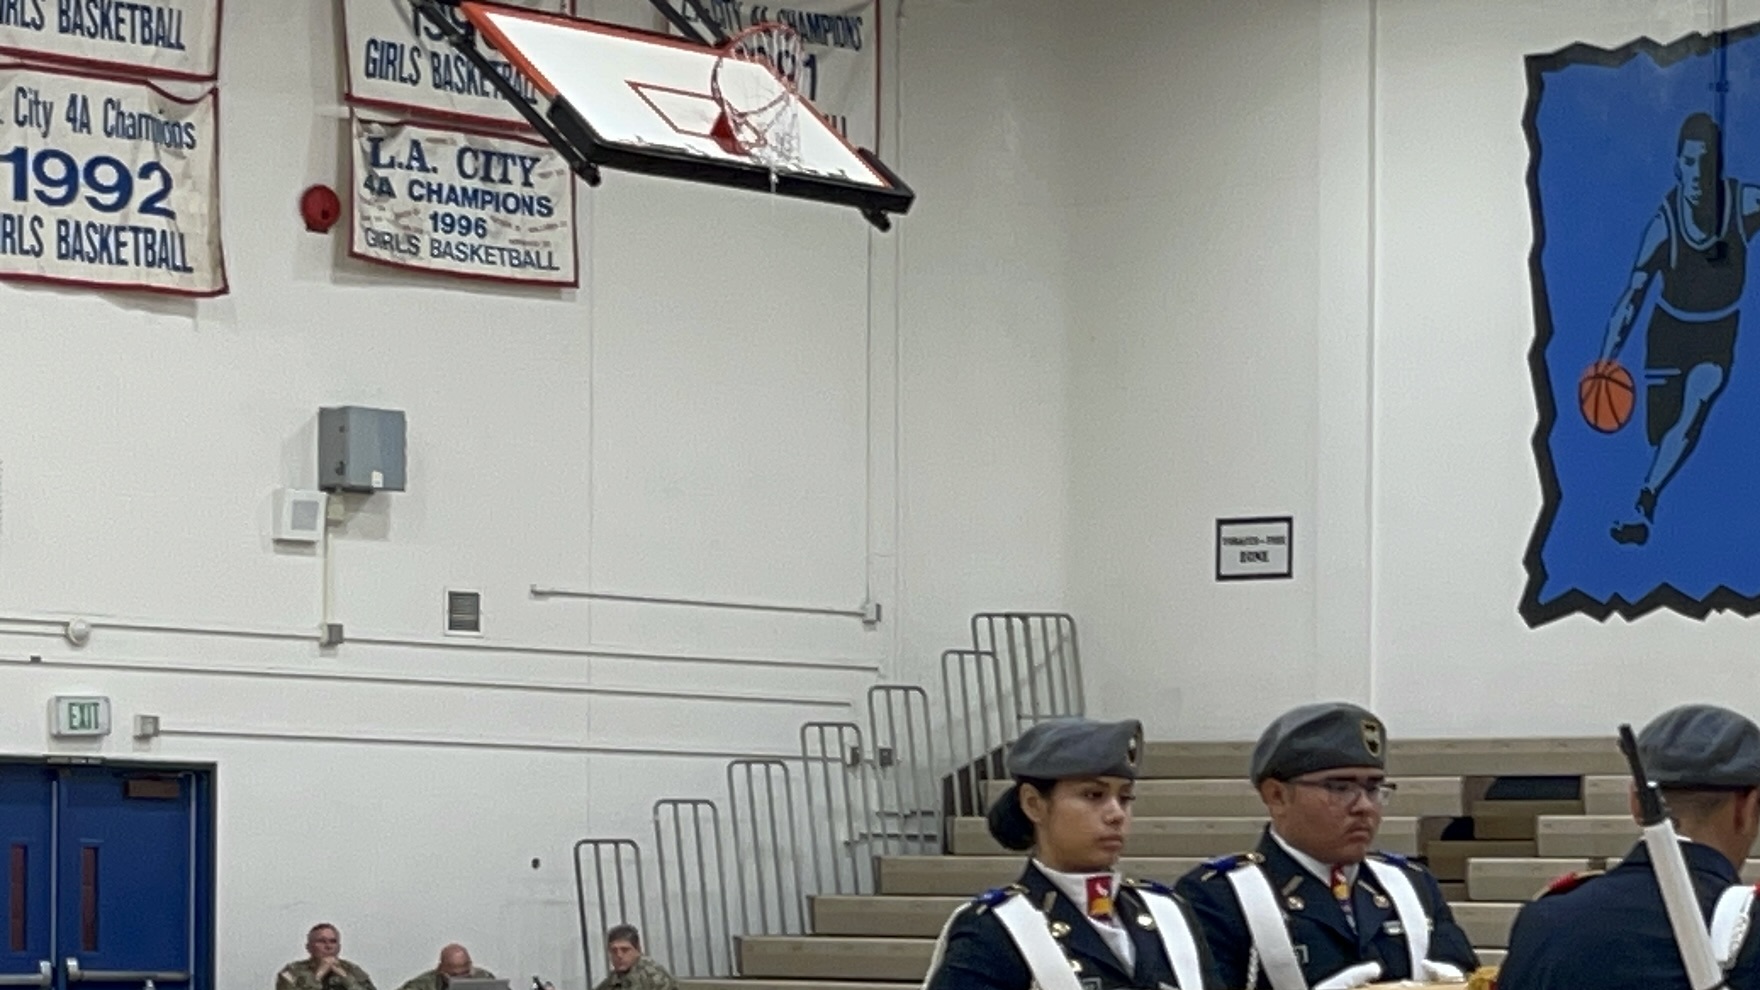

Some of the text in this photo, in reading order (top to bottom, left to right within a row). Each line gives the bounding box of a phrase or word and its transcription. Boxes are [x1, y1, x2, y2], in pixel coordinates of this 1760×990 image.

[0, 0, 185, 50] IRLS BASKETBALL
[364, 38, 421, 87] GIRLS
[14, 86, 54, 138] City
[65, 93, 92, 135] 4A
[0, 146, 176, 220] 1992
[367, 137, 541, 188] L.A. CITY
[363, 174, 554, 218] 4A CHAMPIONS
[1, 213, 194, 273] RLS BASKETBALL
[364, 227, 561, 271] GIRLS BASKETBALL
[429, 211, 488, 239] 1996
[68, 702, 99, 730] EXIT
